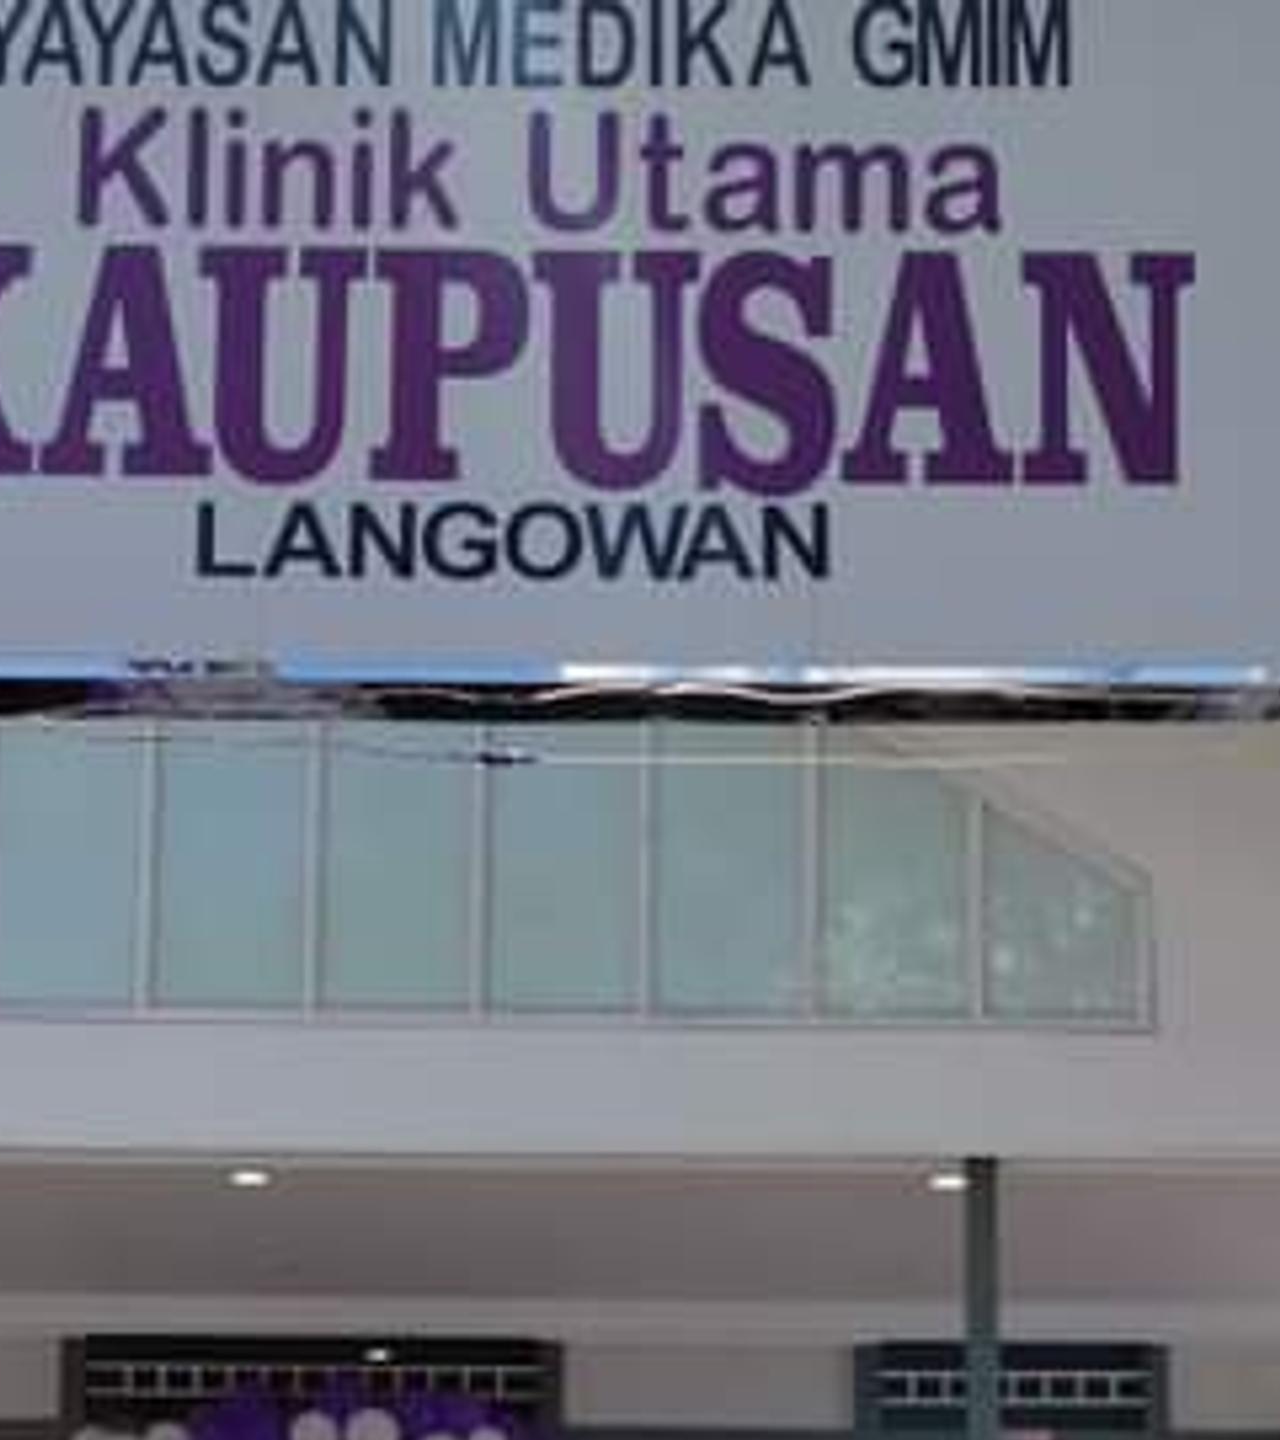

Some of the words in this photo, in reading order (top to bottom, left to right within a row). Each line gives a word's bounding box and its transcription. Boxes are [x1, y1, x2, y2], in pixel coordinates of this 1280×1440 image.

[432, 0, 811, 87] MEDIKA
[852, 0, 1071, 88] GMIM
[76, 106, 459, 229] Klinik
[527, 110, 1002, 234] Utama
[195, 500, 831, 581] LANGOWAN
